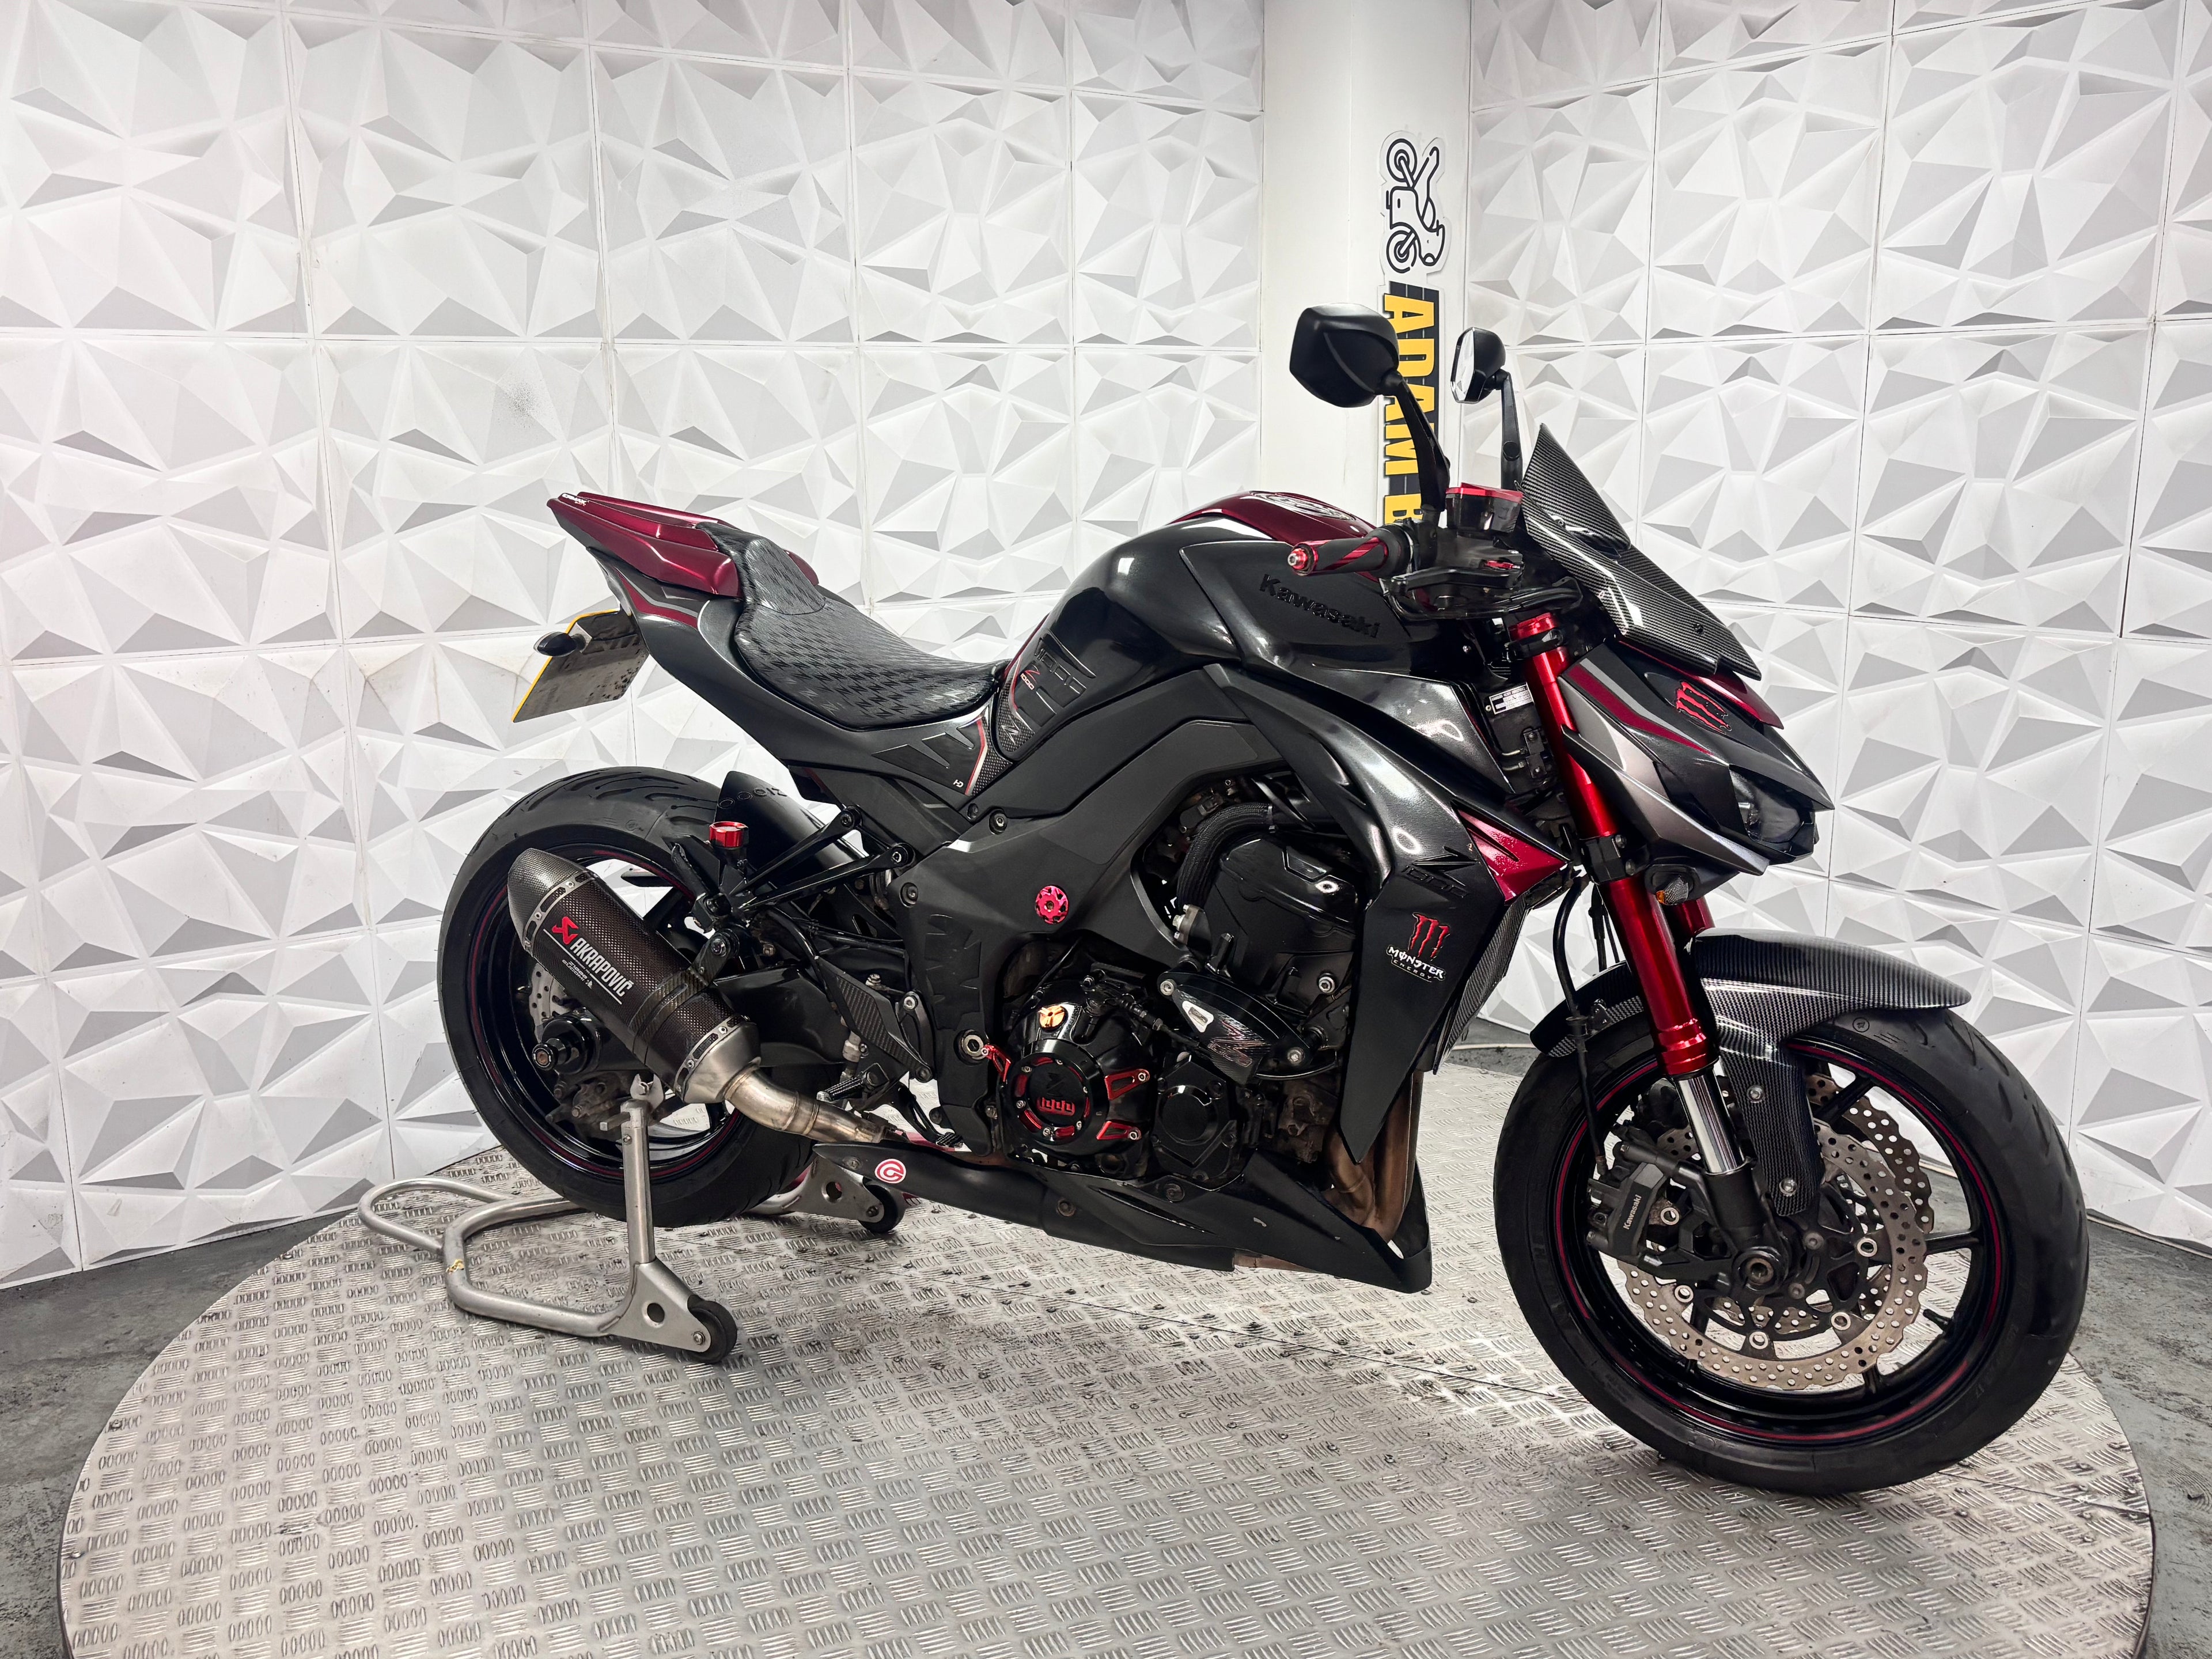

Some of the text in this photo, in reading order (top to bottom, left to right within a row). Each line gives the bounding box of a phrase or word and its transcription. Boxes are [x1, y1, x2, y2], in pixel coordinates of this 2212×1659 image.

[1260, 573, 1380, 638] Kawasaki
[1387, 945, 1446, 981] MONSTER
[1393, 960, 1433, 981] ENERGY
[1623, 1194, 1642, 1230] Kawasaki
